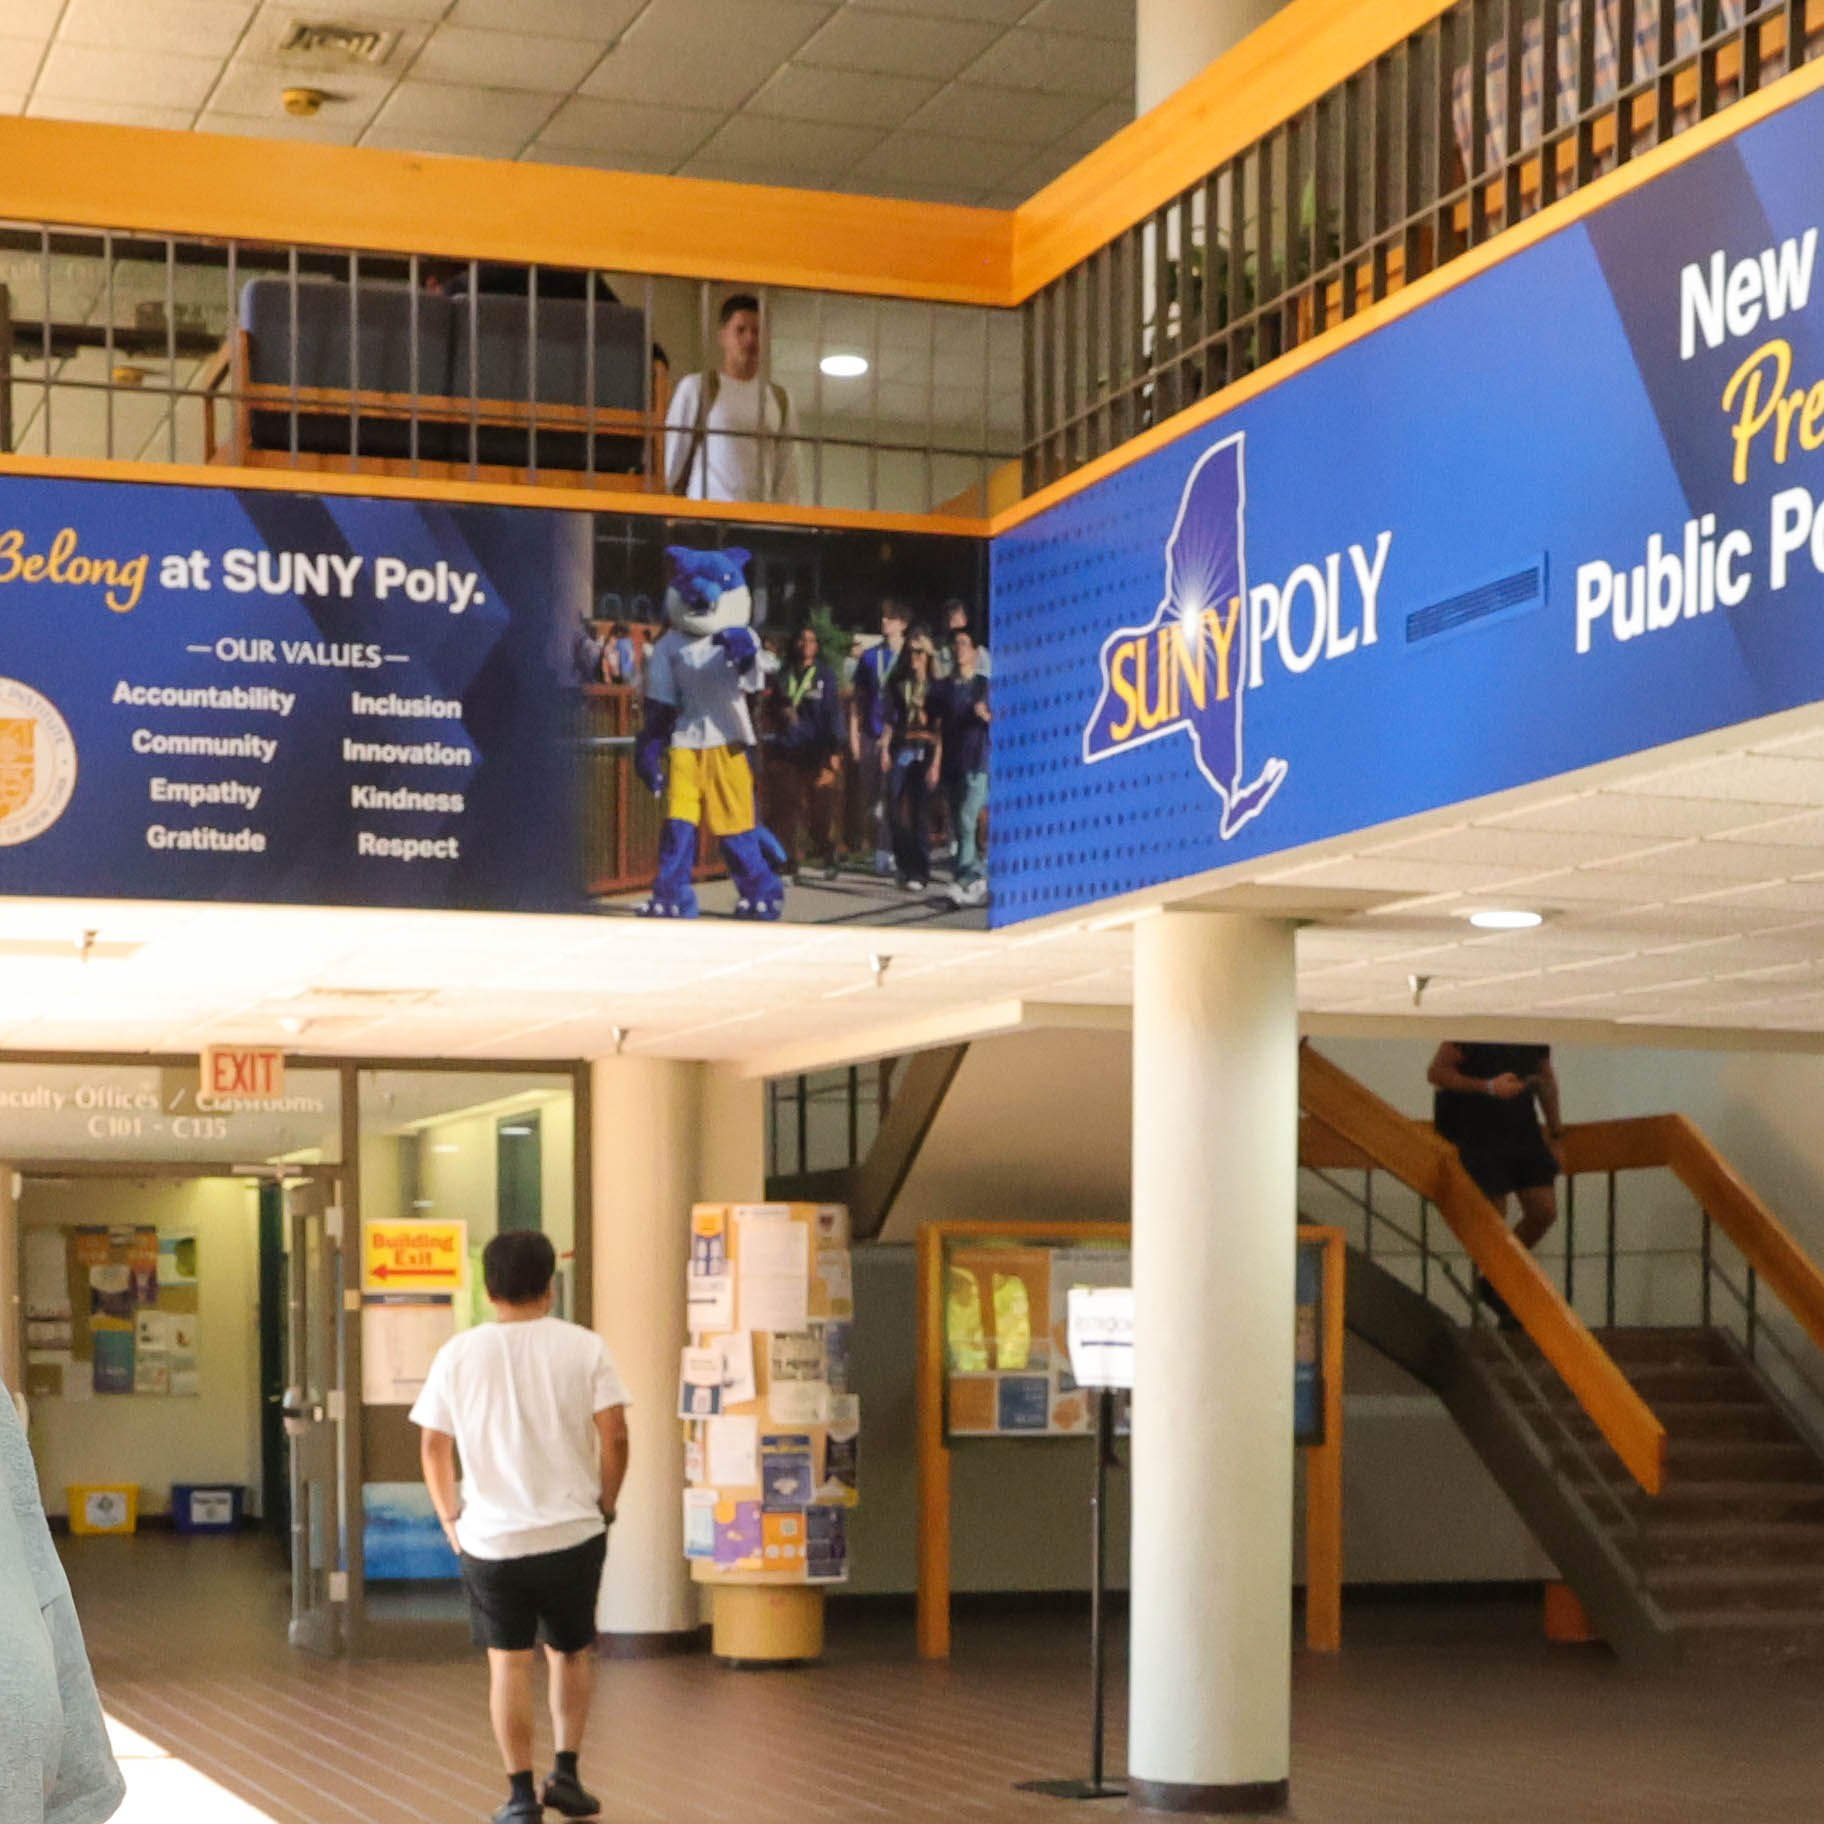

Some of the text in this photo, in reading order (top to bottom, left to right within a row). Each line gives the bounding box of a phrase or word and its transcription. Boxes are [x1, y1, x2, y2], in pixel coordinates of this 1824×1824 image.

[1680, 227, 1818, 361] New
[159, 549, 212, 591] at
[222, 548, 364, 598] SUNY
[375, 557, 486, 613] Poly.
[1576, 513, 1753, 654] Public
[1109, 530, 1393, 741] SUNY POLY
[215, 637, 383, 668] OUR VALUES
[112, 680, 296, 716] Accountability
[351, 691, 462, 719] Inclusion
[131, 728, 277, 763] Community
[342, 738, 471, 767] Innovation
[149, 777, 263, 811] Empathy
[351, 785, 465, 813] Kindness
[146, 824, 267, 853] Gratitude
[358, 832, 460, 861] Respect
[213, 1052, 277, 1093] EXIT
[373, 1233, 455, 1252] Building
[394, 1251, 433, 1266] Exit
